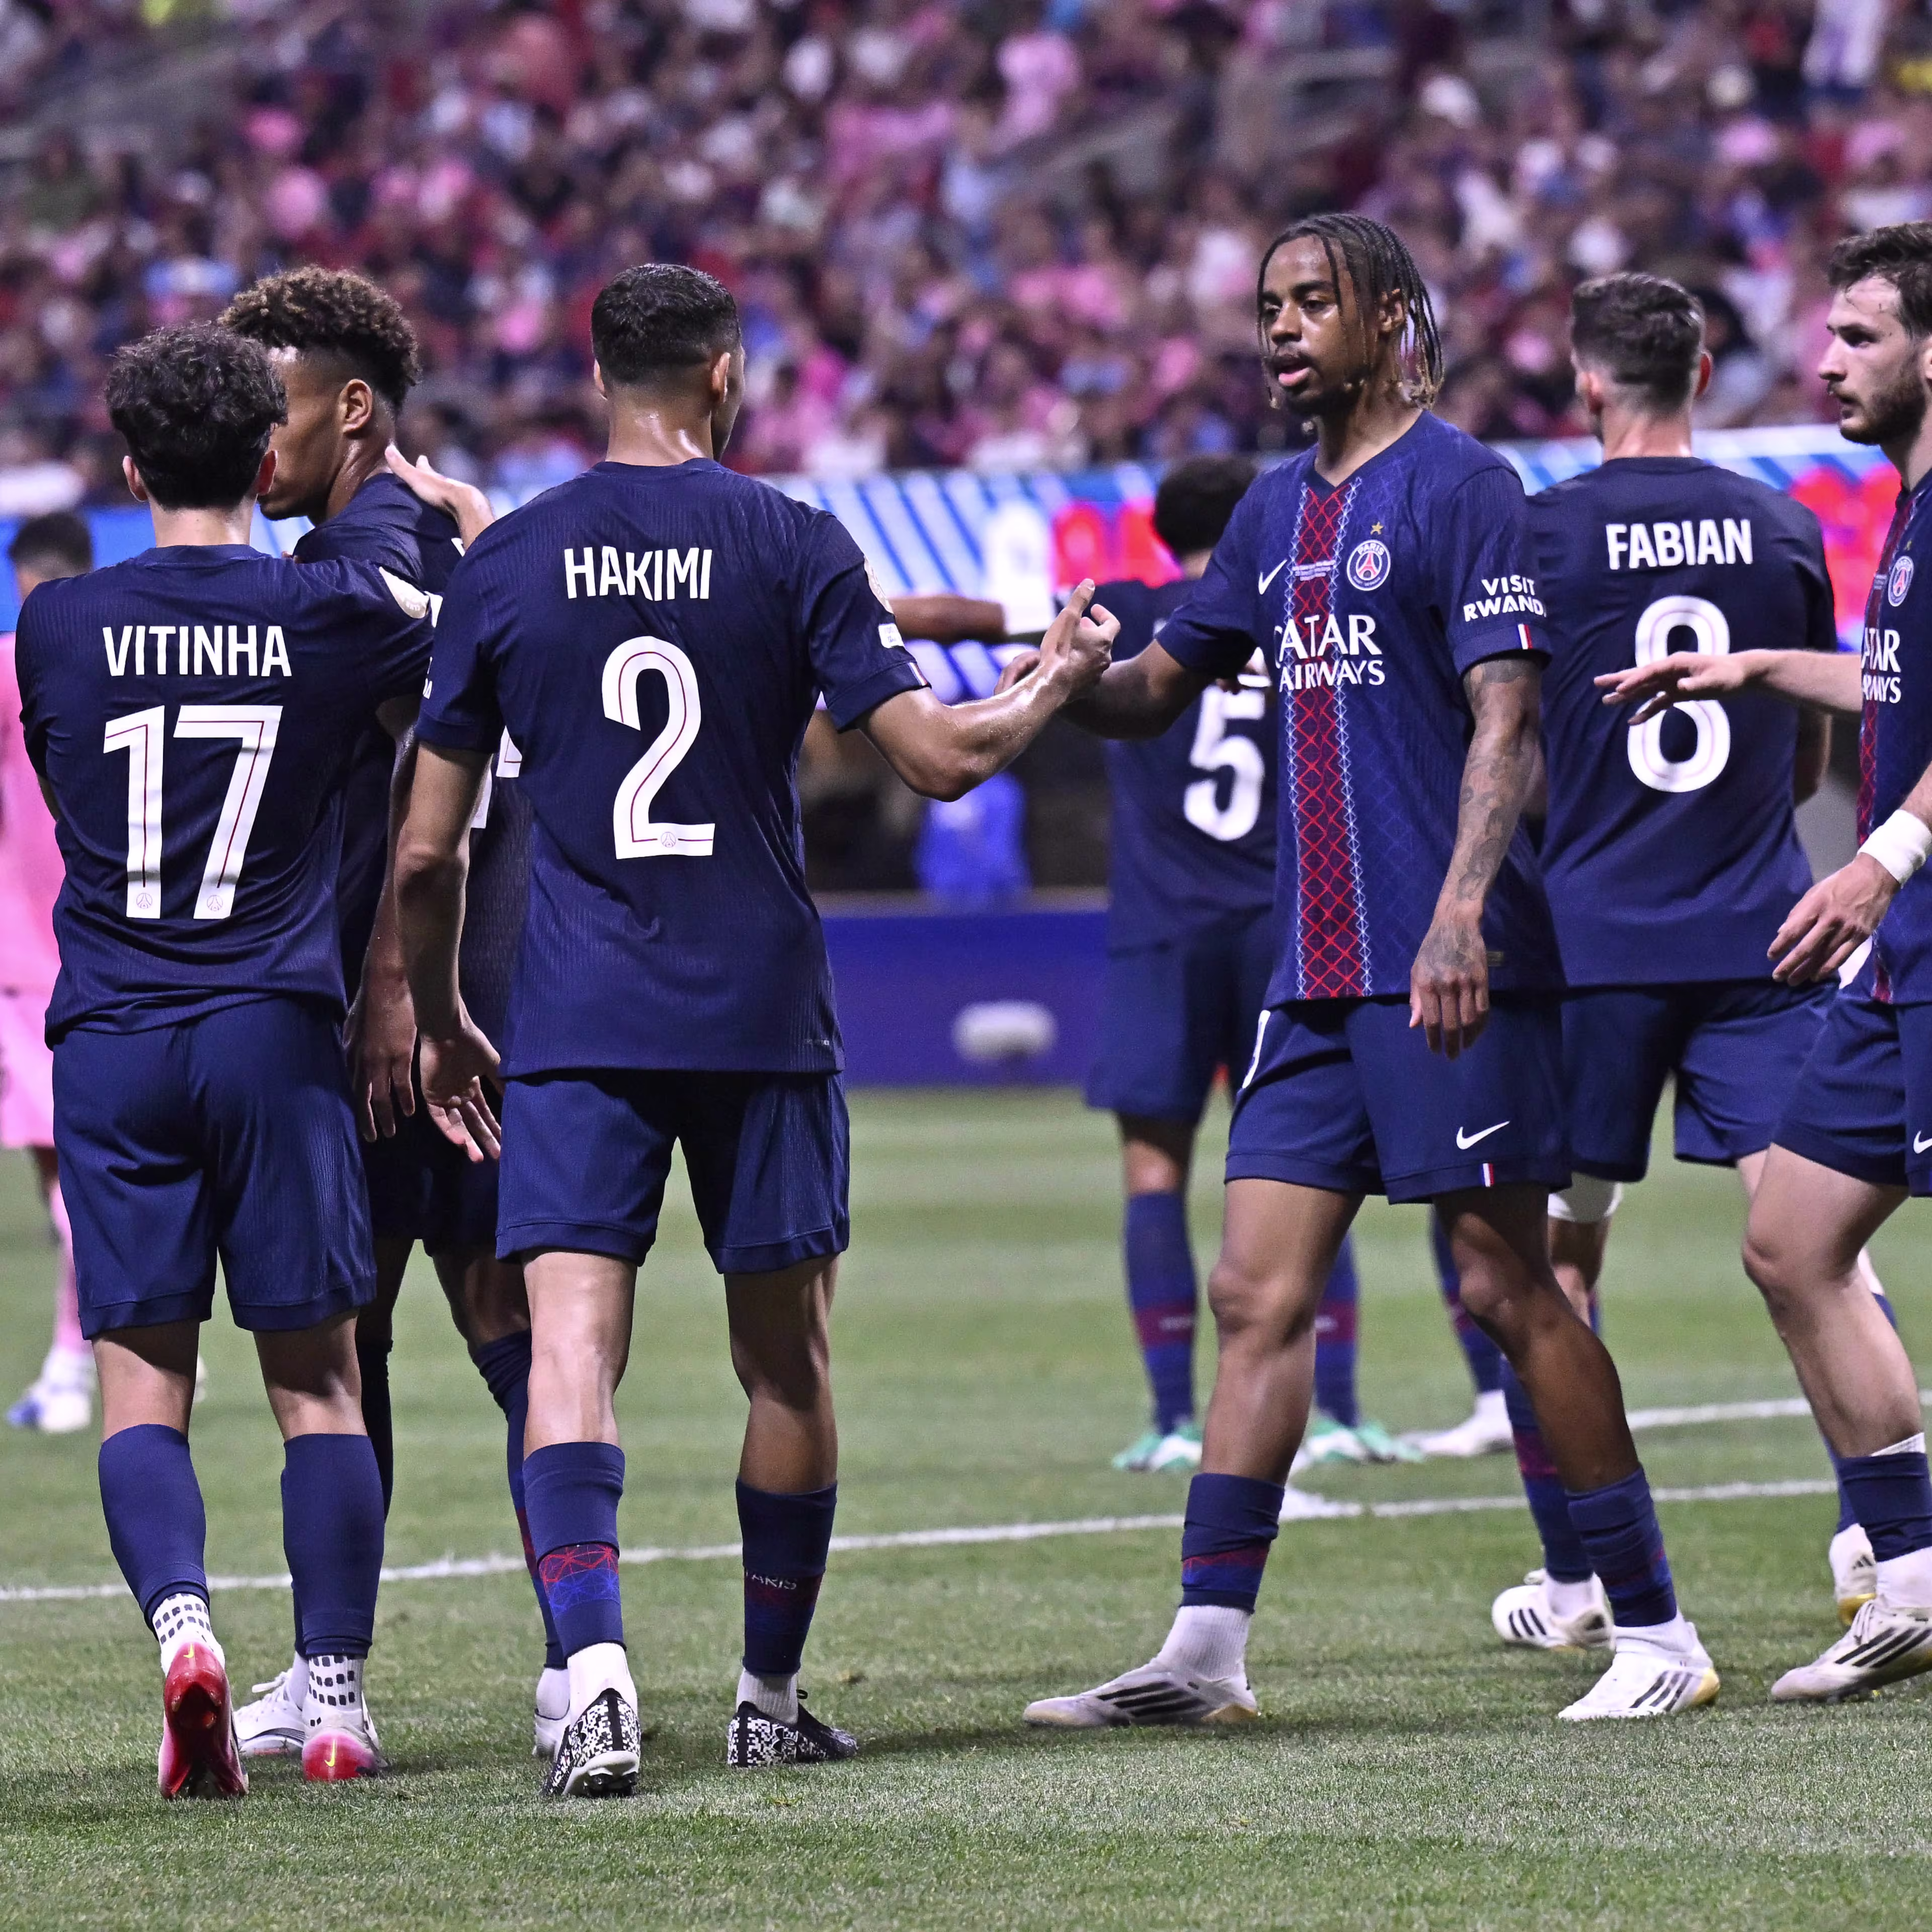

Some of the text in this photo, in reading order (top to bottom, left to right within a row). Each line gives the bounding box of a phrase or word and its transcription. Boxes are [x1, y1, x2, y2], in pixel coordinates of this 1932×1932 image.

[1357, 542, 1385, 555] PARIS
[1605, 518, 1753, 570] FABIAN
[564, 545, 712, 601] HAKIMI
[1481, 575, 1535, 596] VISIT
[1463, 595, 1547, 622] RWAND
[102, 625, 292, 677] VITINHA
[1279, 660, 1385, 692] AIRWAYS
[1627, 595, 1731, 793] 8
[601, 635, 715, 859] 2
[1183, 684, 1265, 841] 5
[103, 705, 283, 919] 17
